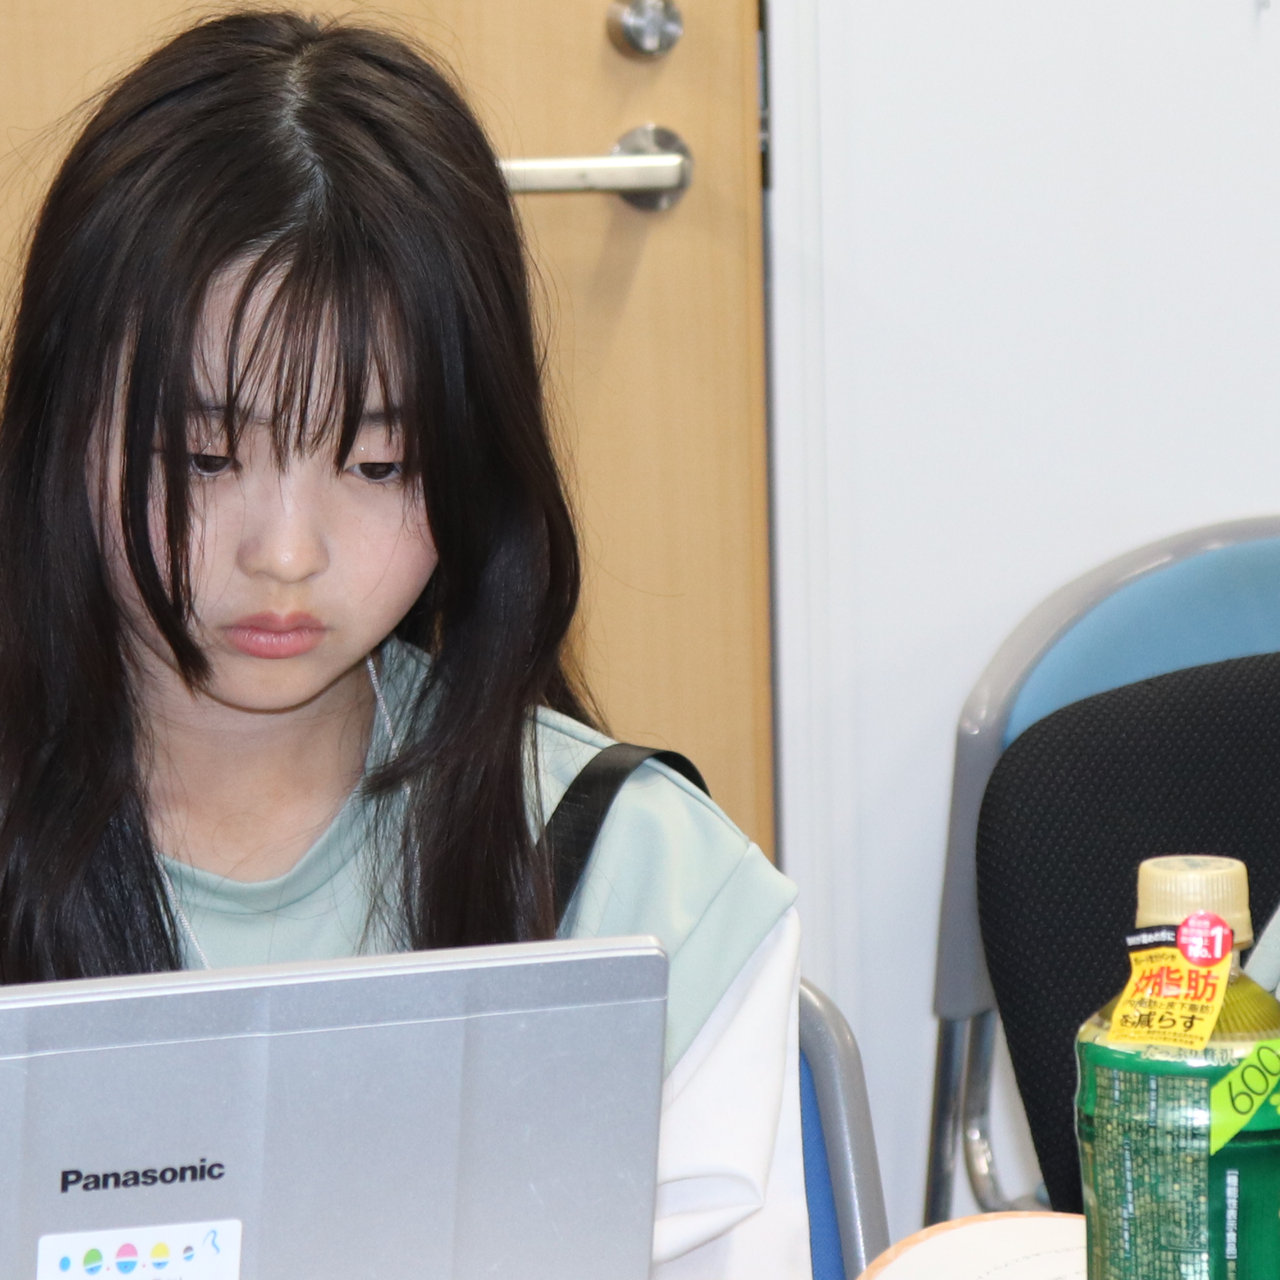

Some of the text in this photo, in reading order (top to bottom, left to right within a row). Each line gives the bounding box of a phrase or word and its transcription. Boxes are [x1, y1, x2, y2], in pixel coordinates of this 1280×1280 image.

[1120, 1010, 1205, 1032] を減らす
[61, 1158, 225, 1193] Panasonic
